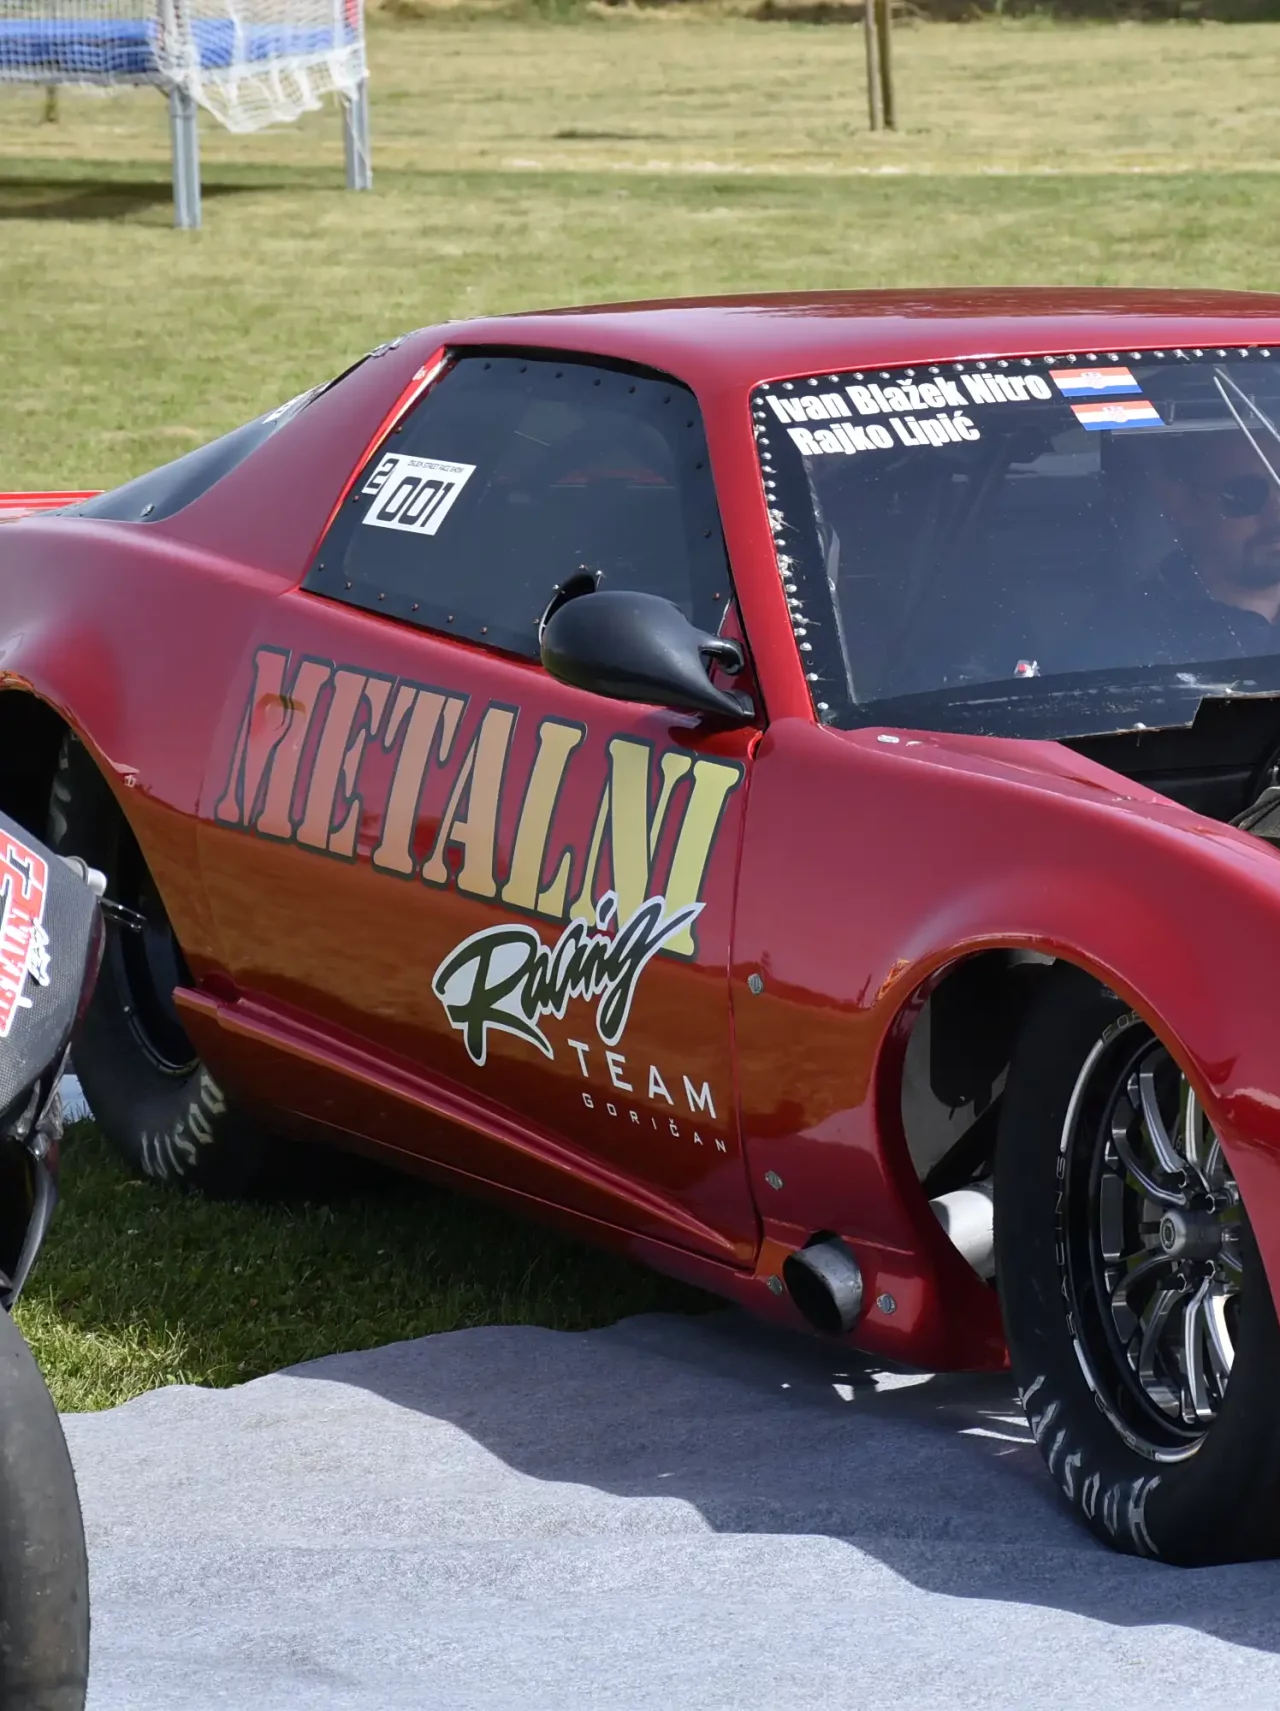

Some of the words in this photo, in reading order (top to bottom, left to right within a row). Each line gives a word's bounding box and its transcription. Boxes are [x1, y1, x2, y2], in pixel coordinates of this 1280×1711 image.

[766, 390, 849, 424] Ivan
[846, 377, 968, 415] Blažek
[961, 371, 1052, 405] Nitro
[788, 422, 894, 456] Rajko
[889, 410, 981, 448] Lipić
[376, 476, 456, 528] 001
[215, 644, 745, 957] METALNI
[432, 890, 706, 1066] Racing
[567, 1038, 717, 1119] TEAM
[582, 1092, 727, 1153] GORIČAN
